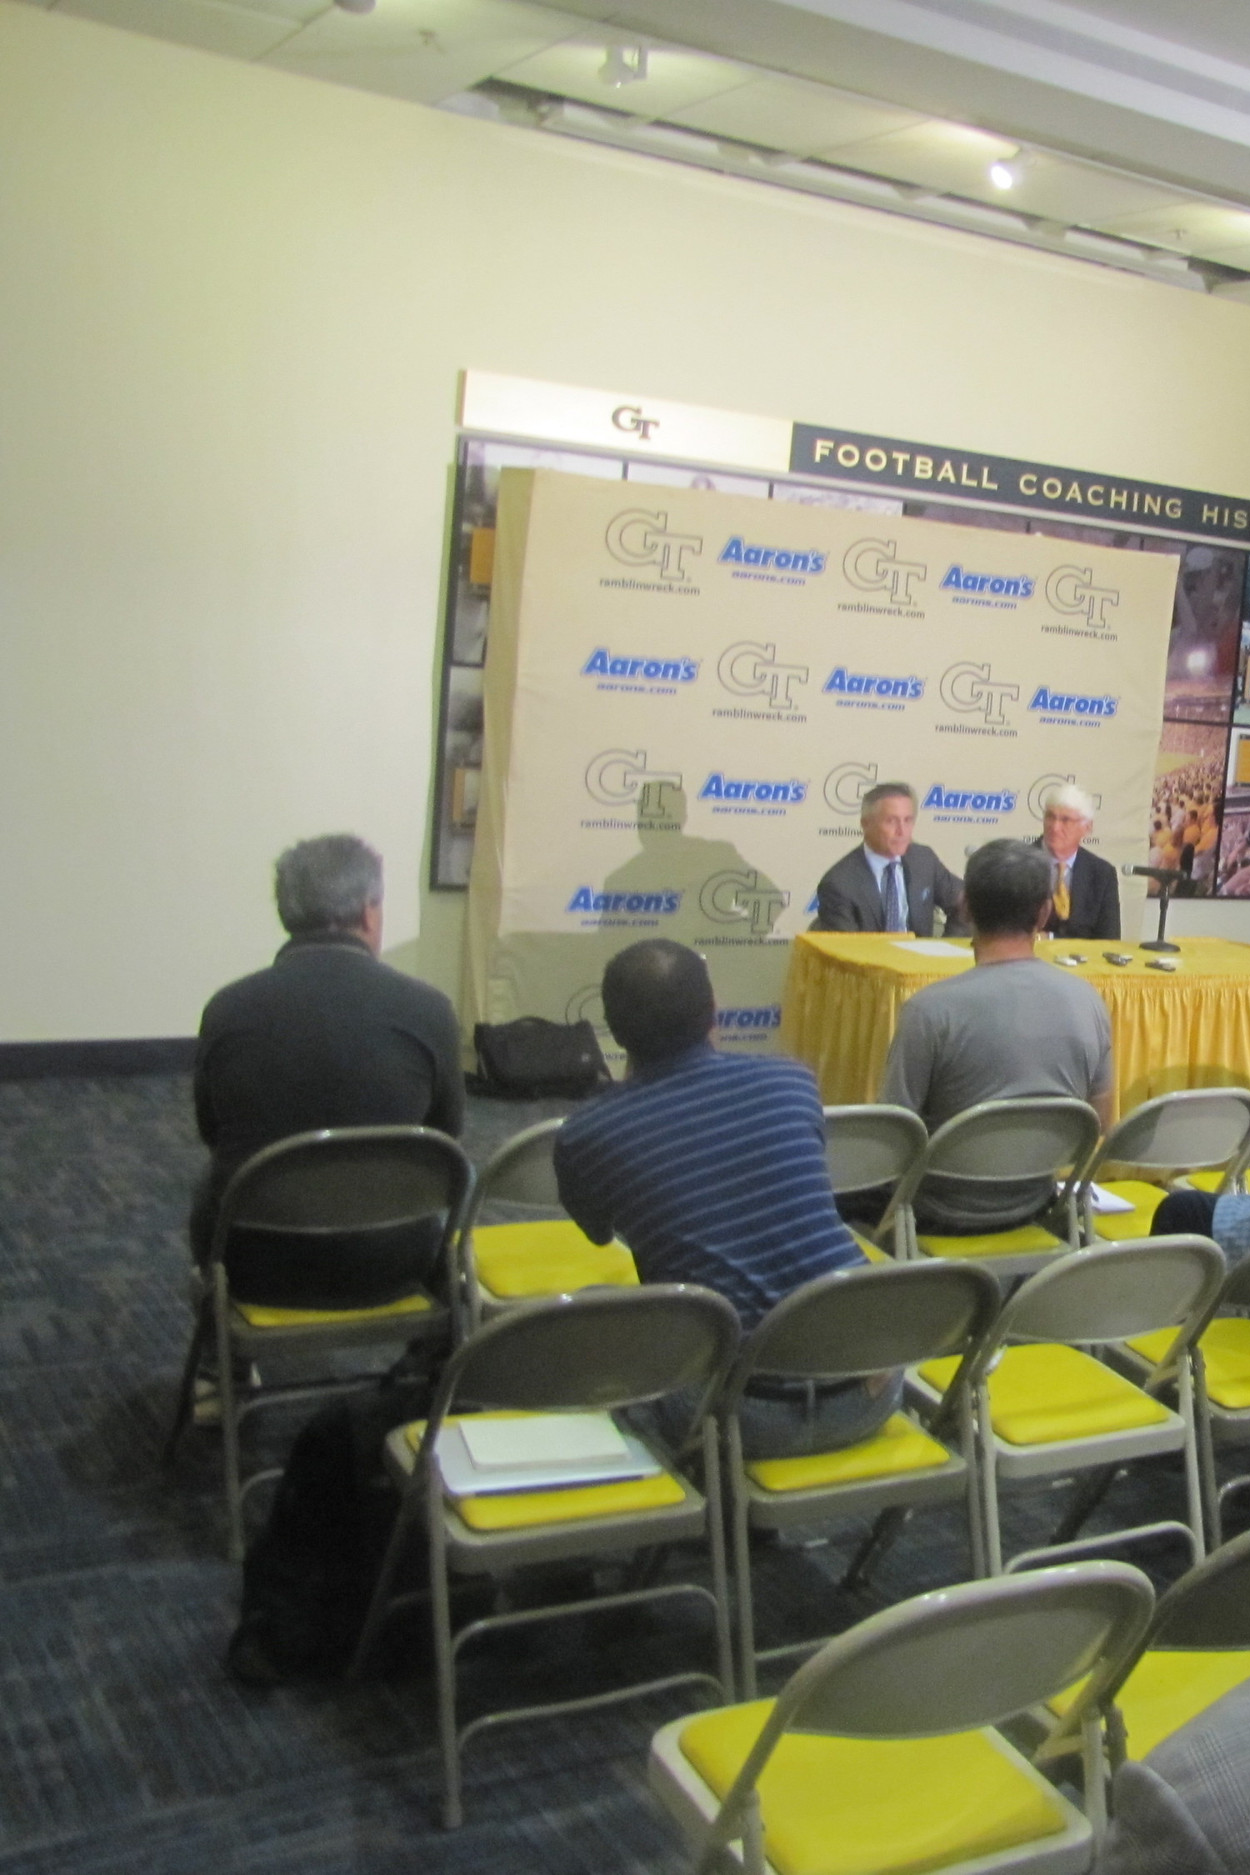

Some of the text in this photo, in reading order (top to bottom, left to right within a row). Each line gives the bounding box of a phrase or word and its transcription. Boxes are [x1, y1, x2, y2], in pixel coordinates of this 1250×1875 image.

[612, 406, 660, 440] GT
[815, 439, 999, 491] FOOTBALL
[1019, 474, 1183, 520] COACHING
[605, 508, 703, 581] GT
[719, 537, 827, 573] Aaron's
[600, 578, 700, 596] ramblinwreck.com
[843, 538, 927, 606] GT
[940, 565, 1035, 598] Aaron's
[838, 602, 925, 619] ramblinwreck.com
[1046, 565, 1120, 628] GT
[1041, 624, 1118, 641] ramblinwreck.com
[583, 648, 698, 682] Aaron's
[718, 640, 809, 709] GT
[823, 668, 924, 699] Aaron's
[940, 661, 1020, 725] GT
[712, 708, 807, 723] ramblinwreck.com
[1028, 687, 1117, 717] Aaron's
[935, 724, 1018, 738] ramblinwreck.com
[585, 749, 683, 818] GT
[699, 773, 807, 803] Aaron's
[921, 784, 1017, 811] Aaron's
[581, 818, 681, 832] ramblinwreck.com
[566, 885, 681, 915] Aaron's
